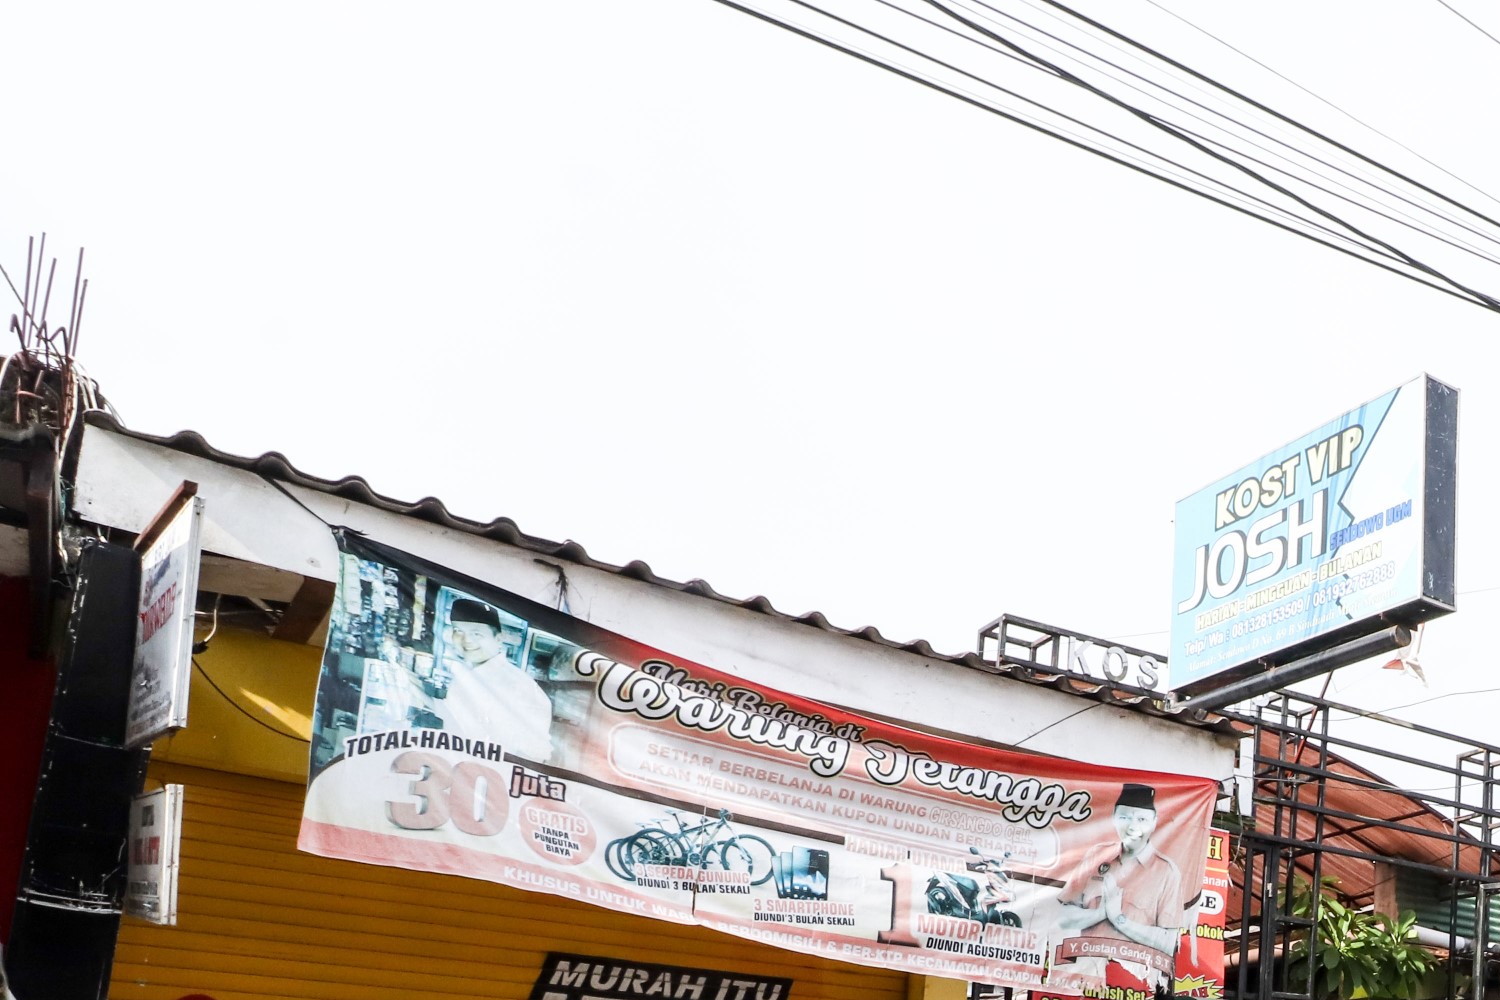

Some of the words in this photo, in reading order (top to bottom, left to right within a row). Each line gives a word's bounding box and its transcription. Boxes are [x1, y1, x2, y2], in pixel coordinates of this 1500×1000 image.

[1216, 452, 1301, 531] KOST
[1305, 424, 1364, 483] VIP
[1329, 512, 1383, 551] SENDOWO
[1386, 499, 1412, 526] UGM
[1178, 488, 1328, 614] JOSH
[1196, 601, 1239, 632] HARIAN
[1245, 571, 1311, 611] MINGGUAN
[1319, 540, 1383, 582] BULANAN
[1232, 600, 1303, 638] 081328153509
[1067, 636, 1161, 692] KOS
[642, 660, 725, 700] Mari
[727, 687, 833, 735] Belanja
[835, 723, 866, 743] di
[347, 730, 411, 758] TOTAL
[421, 730, 502, 762] HADIAH
[575, 650, 850, 778] Warung
[862, 739, 1093, 829] Tetangga
[385, 750, 511, 837] 30
[509, 765, 566, 803] juta
[639, 759, 691, 783] AKAN
[696, 771, 829, 815] MENDAPATKAN
[831, 802, 889, 828] KUPON
[892, 818, 951, 842] UNDIAN
[955, 831, 1038, 858] BERHADIAH
[647, 741, 714, 767] SETIAP
[718, 759, 833, 799] BERBELANJA
[838, 787, 856, 801] DI
[860, 794, 928, 819] WARUNG
[1004, 825, 1034, 846] CELL
[527, 805, 588, 835] GRATIS
[541, 826, 571, 841] TANPA
[534, 832, 579, 852] PUNGUTAN
[545, 844, 571, 858] BIAYA
[845, 836, 907, 863] HADIAH
[911, 849, 965, 874] UTAMA
[637, 876, 670, 890] DIUNDI
[672, 881, 679, 891] 3
[681, 880, 716, 894] BULAN
[719, 884, 750, 895] SEKALI
[648, 863, 694, 881] SEPEDA
[696, 869, 750, 885] GUNUNG
[754, 898, 763, 911] 3
[766, 900, 855, 916] SMARTPHONE
[754, 912, 785, 923] DIUNDI
[788, 914, 794, 924] 3
[796, 914, 823, 925] BULAN
[826, 916, 855, 926] SEKALI
[877, 862, 919, 948] 1
[504, 865, 581, 896] KHUSUS
[586, 884, 648, 913] UNTUK
[651, 903, 714, 928] WARA
[718, 921, 822, 951] BERDOMISILI
[906, 954, 990, 978] KECAMATAN
[993, 965, 1042, 984] GAMPIN
[916, 914, 980, 943] MOTOR
[985, 925, 1038, 950] MATIC
[926, 937, 964, 953] DIUNDI
[966, 943, 1014, 961] AGUSTUS
[1015, 951, 1041, 966] 2019
[1070, 942, 1078, 953] Y.
[1081, 942, 1117, 955] Gustan
[549, 960, 706, 1000] MURAH
